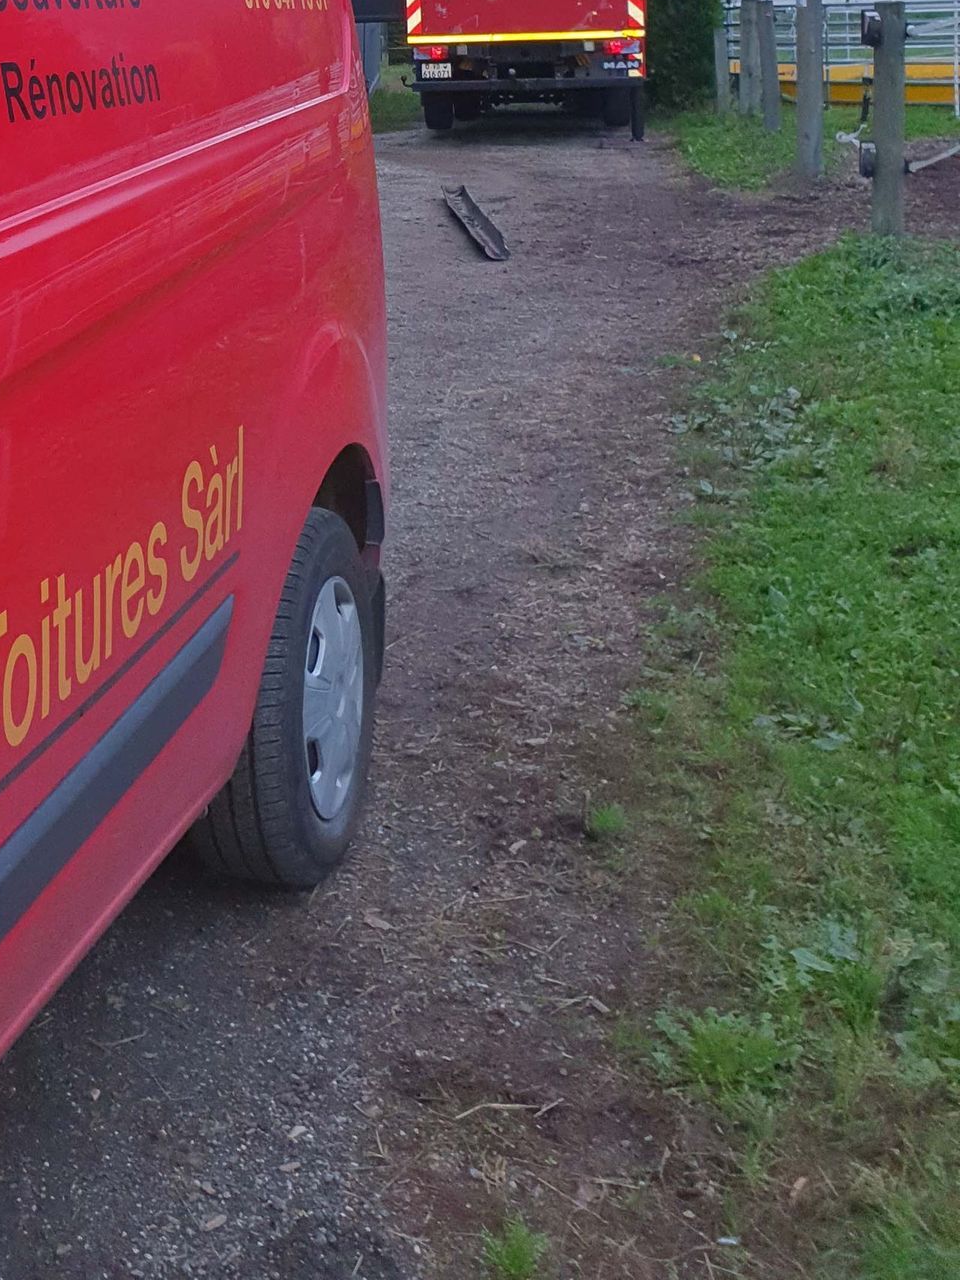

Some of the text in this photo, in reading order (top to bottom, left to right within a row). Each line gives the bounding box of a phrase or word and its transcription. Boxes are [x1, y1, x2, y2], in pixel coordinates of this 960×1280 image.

[0, 52, 161, 123] Rénovation
[603, 61, 639, 69] MAN
[180, 424, 244, 582] Sàrl
